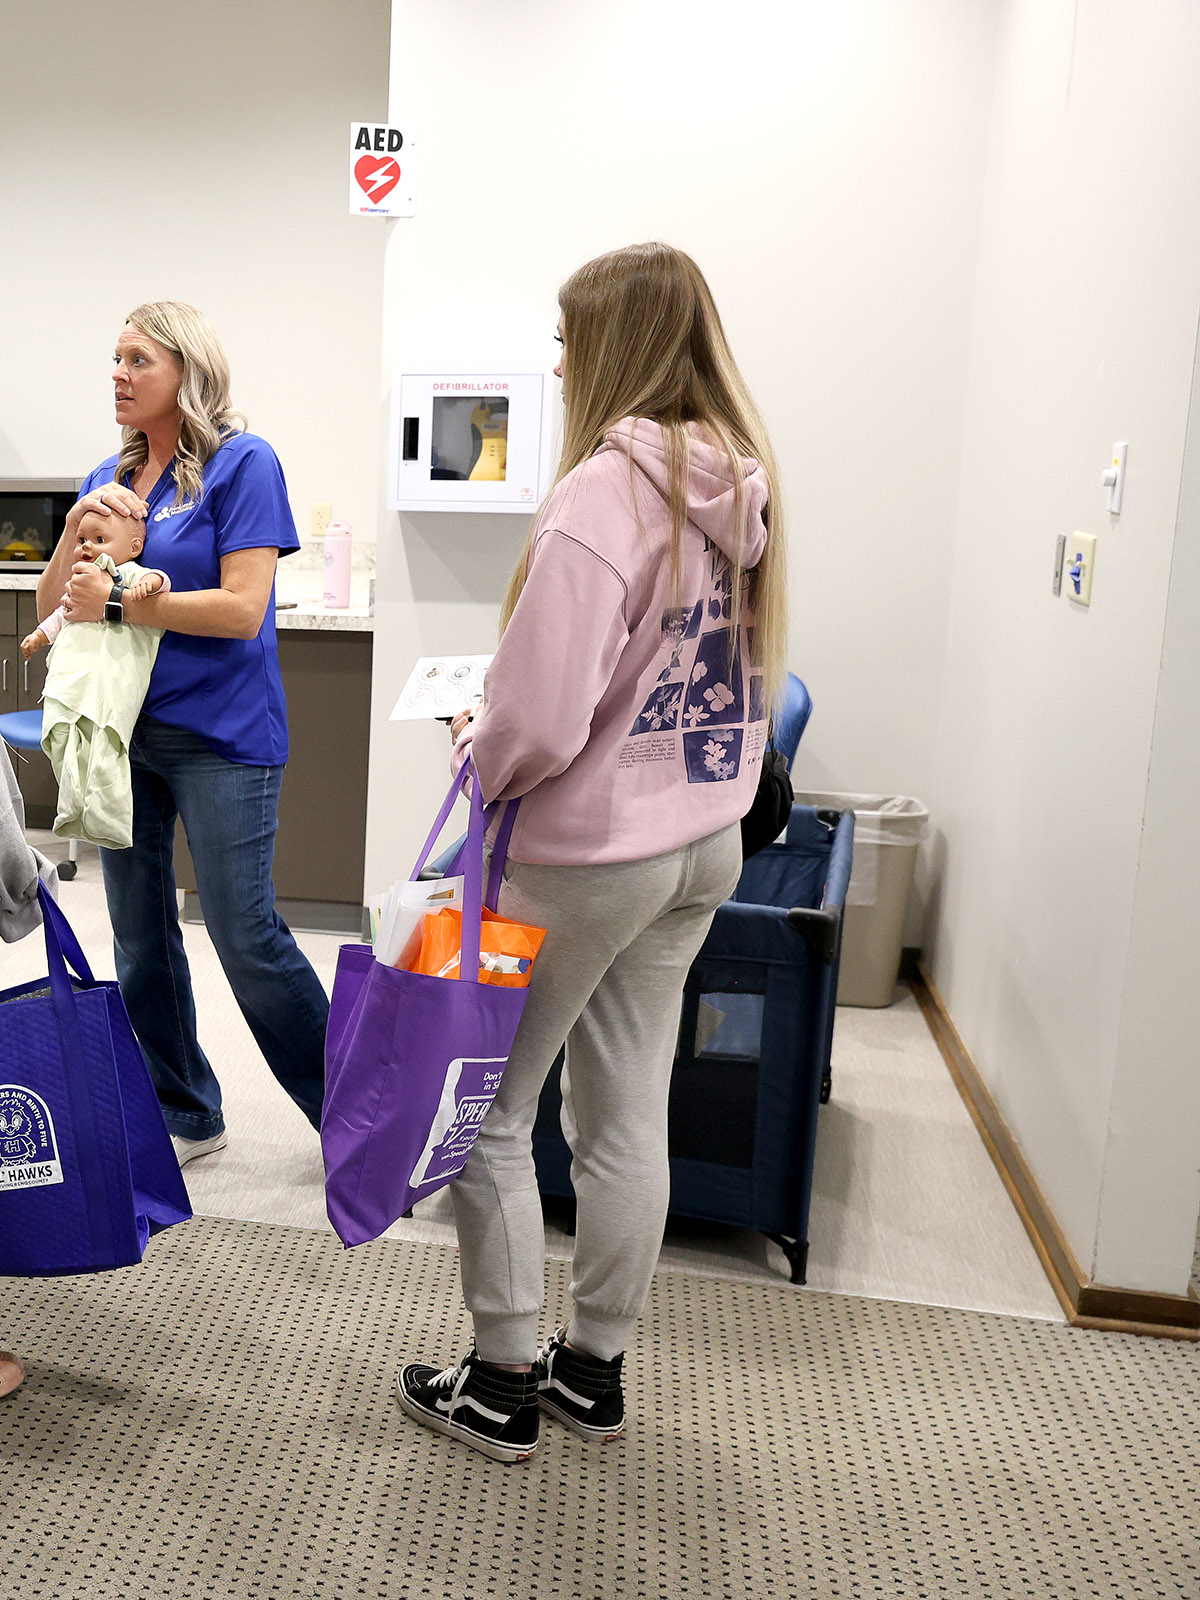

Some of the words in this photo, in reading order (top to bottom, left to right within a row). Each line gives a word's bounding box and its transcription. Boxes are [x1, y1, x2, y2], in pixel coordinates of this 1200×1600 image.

[355, 127, 403, 152] AED
[433, 383, 509, 391] DEFIBRILLATOR
[483, 1082, 491, 1091] in
[11, 1091, 27, 1101] AND
[26, 1099, 42, 1119] BIRTH
[456, 1101, 493, 1124] SPEA
[37, 1119, 45, 1130] TO
[39, 1131, 48, 1148] FIVE
[8, 1165, 53, 1181] HAWKS
